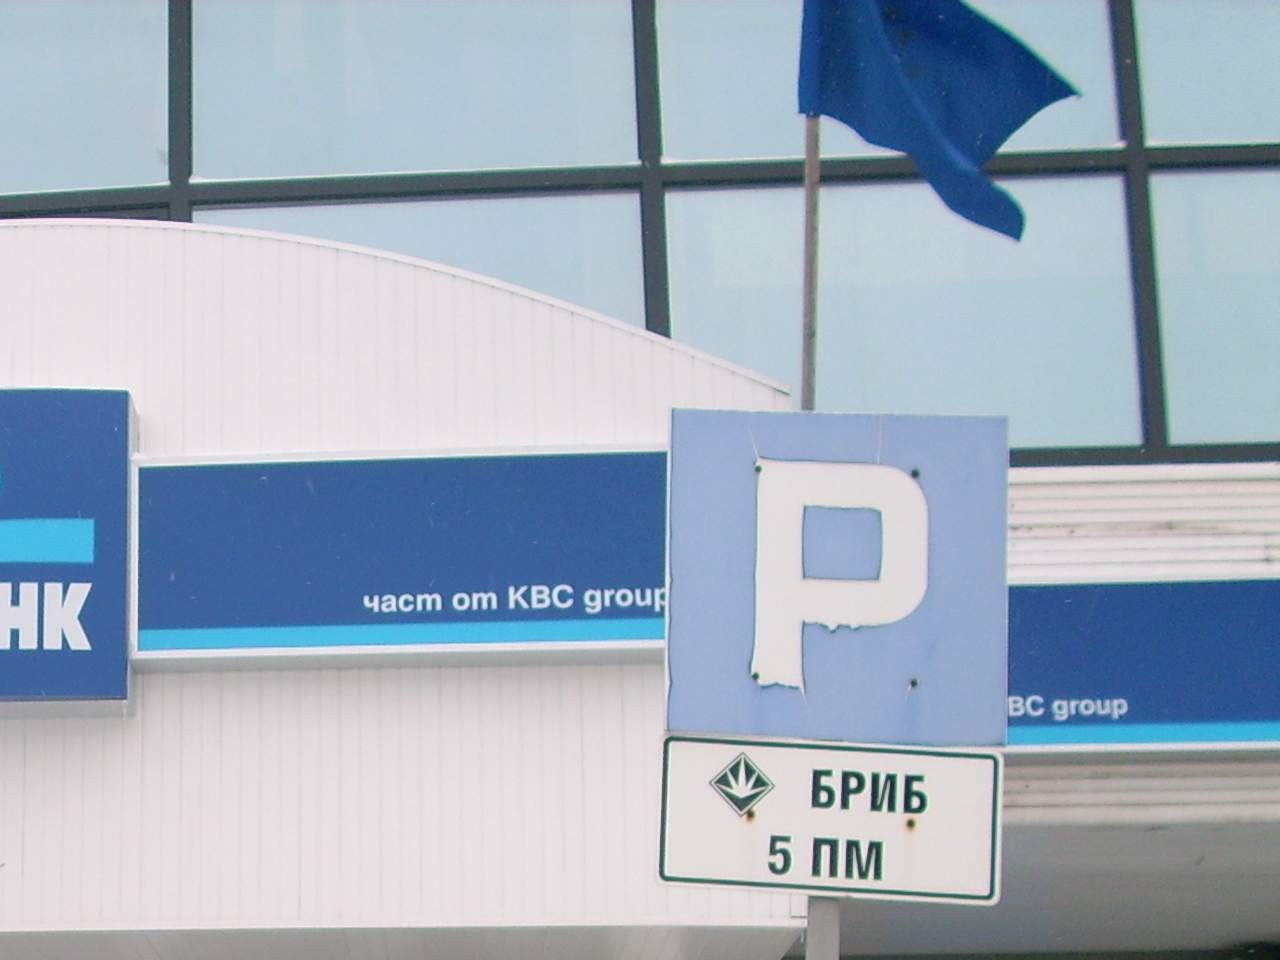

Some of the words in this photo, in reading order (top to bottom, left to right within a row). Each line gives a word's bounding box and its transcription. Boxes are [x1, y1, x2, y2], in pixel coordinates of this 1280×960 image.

[507, 584, 574, 609] KBC
[583, 587, 666, 614] group
[750, 457, 928, 698] P
[1007, 695, 1046, 717] BC
[1051, 698, 1128, 721] group
[810, 769, 929, 815] БРИБ
[767, 835, 793, 876] 5
[811, 837, 883, 881] ПМ
